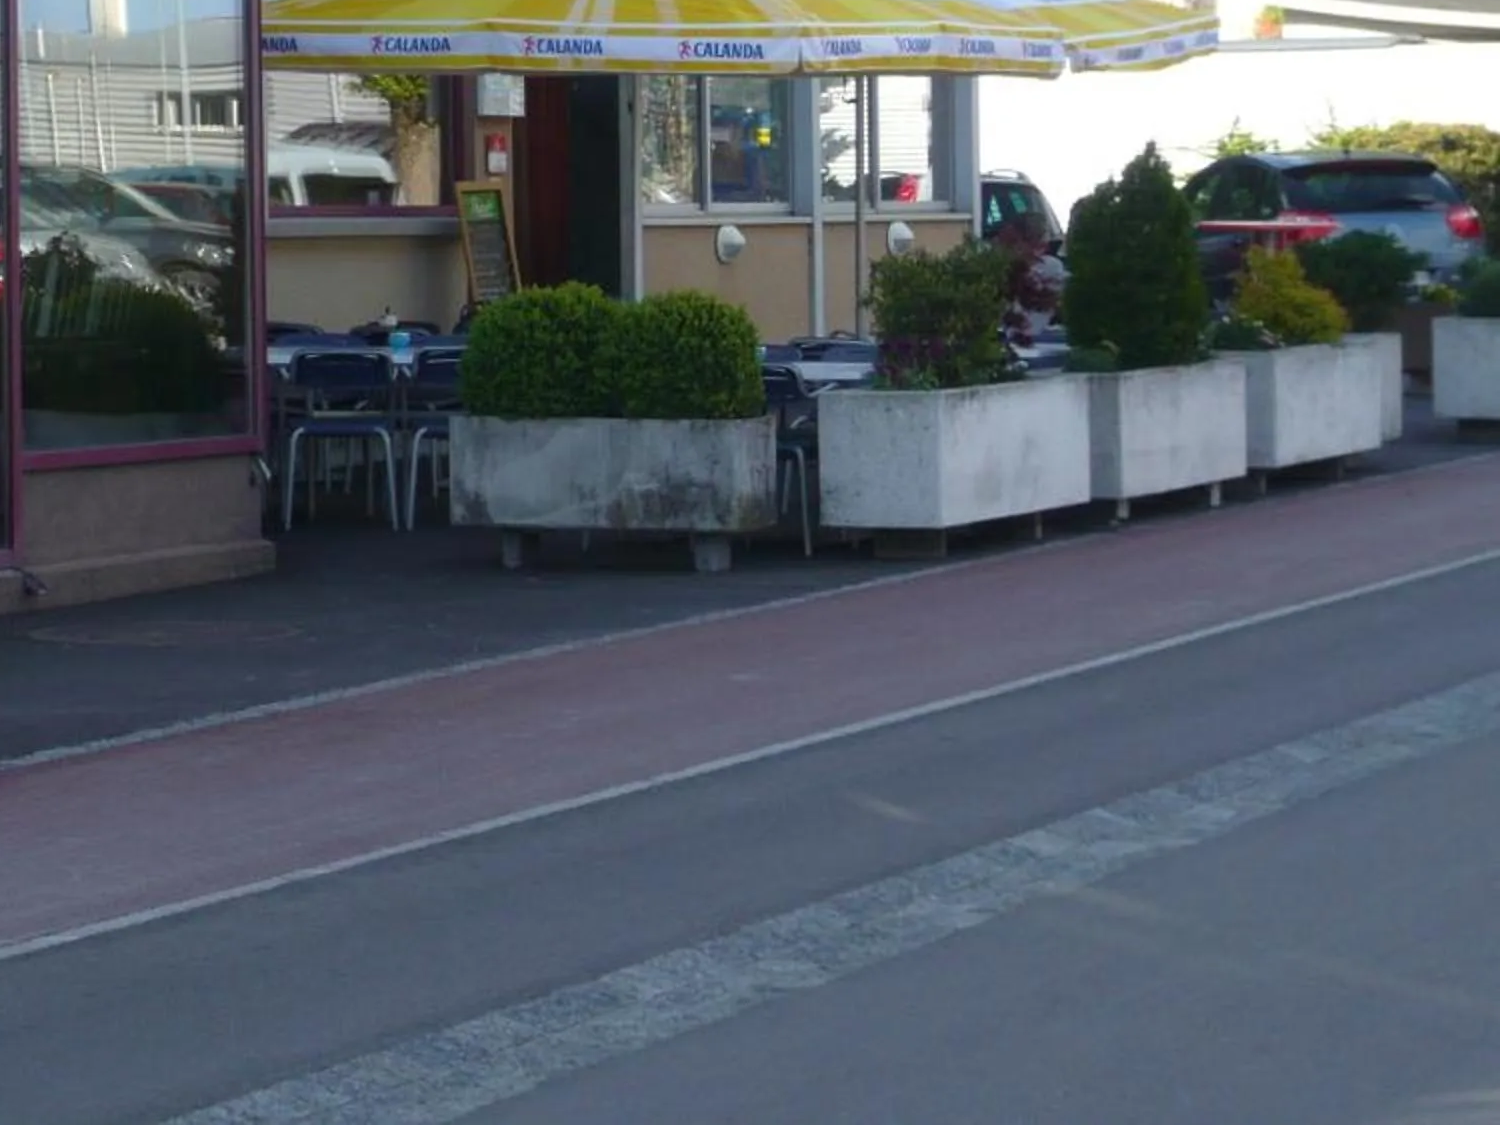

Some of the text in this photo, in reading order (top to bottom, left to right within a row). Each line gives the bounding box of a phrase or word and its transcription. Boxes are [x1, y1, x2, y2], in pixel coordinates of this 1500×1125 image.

[261, 37, 298, 53] ANDA
[385, 36, 452, 53] CALANDA
[536, 37, 603, 54] CALANDA
[693, 41, 765, 60] CALANDA
